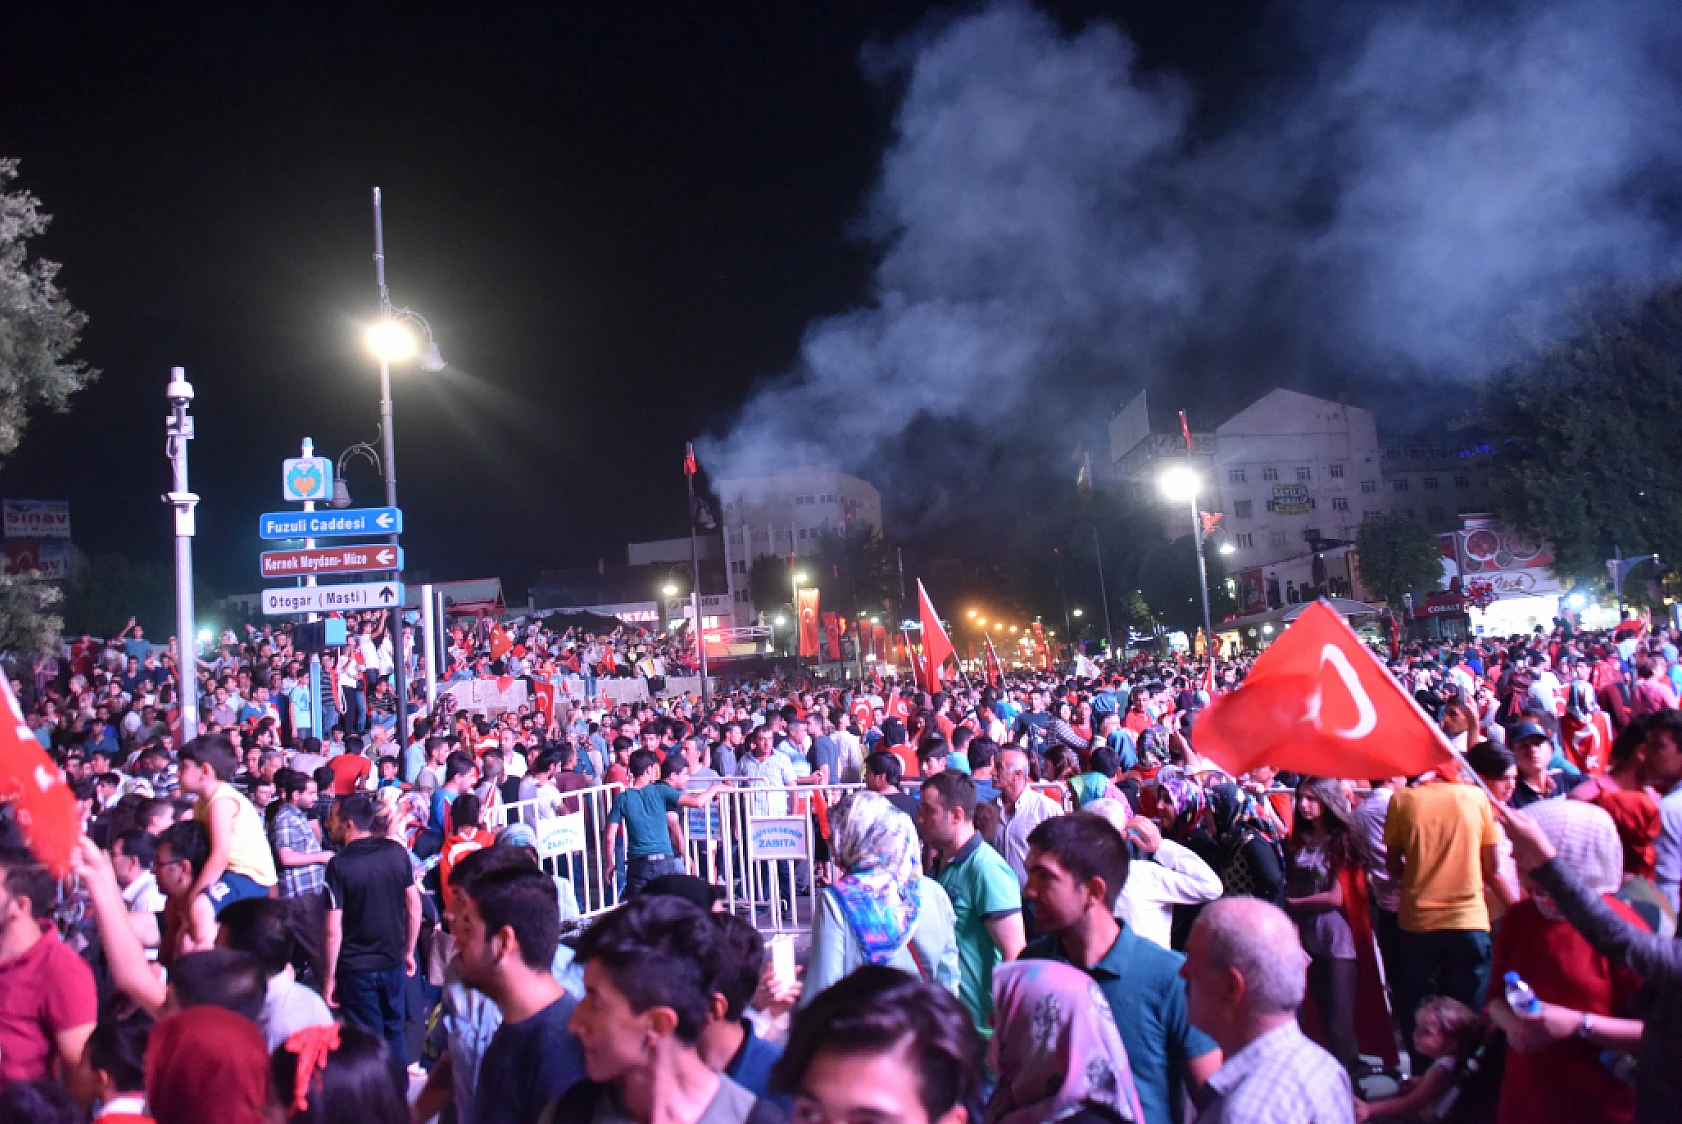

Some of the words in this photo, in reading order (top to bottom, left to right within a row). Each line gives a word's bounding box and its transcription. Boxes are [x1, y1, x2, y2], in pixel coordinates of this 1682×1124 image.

[267, 519, 306, 534] Fuzuli
[310, 516, 366, 532] Caddesi
[265, 556, 298, 571] Kernek
[270, 595, 312, 610] Otogar
[758, 839, 796, 848] ZABITA
